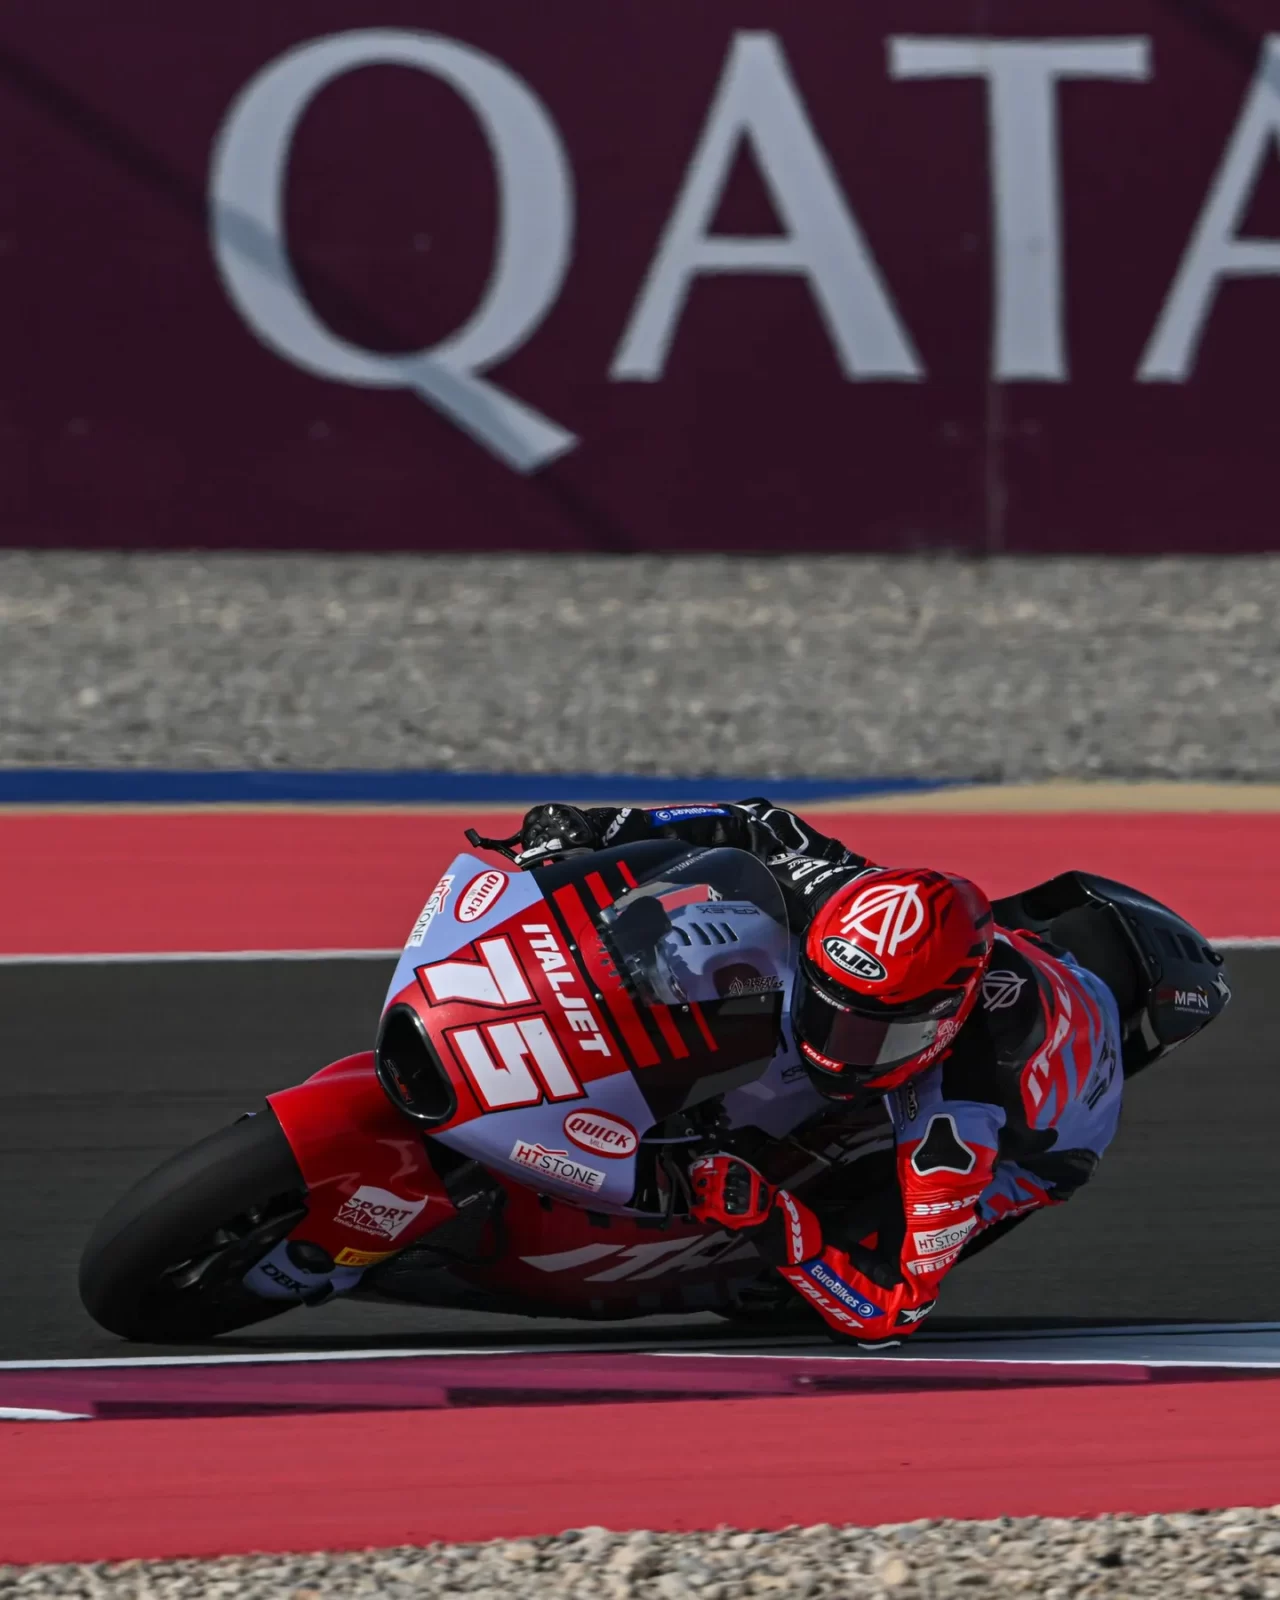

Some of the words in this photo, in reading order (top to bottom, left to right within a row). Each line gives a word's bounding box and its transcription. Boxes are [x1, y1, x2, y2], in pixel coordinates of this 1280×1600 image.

[413, 878, 450, 942] HTSTONE
[464, 873, 500, 918] QUICK
[828, 941, 880, 976] HJC
[521, 923, 612, 1057] ITALJET
[416, 933, 586, 1113] 75
[801, 1043, 842, 1071] ITALJET
[568, 1117, 632, 1149] QUICK
[516, 1145, 599, 1187] HTSTONE
[337, 1205, 403, 1232] VALLEY
[346, 1198, 412, 1222] SPORT
[788, 1274, 864, 1329] ITALJET
[811, 1264, 860, 1308] EuroBikes
